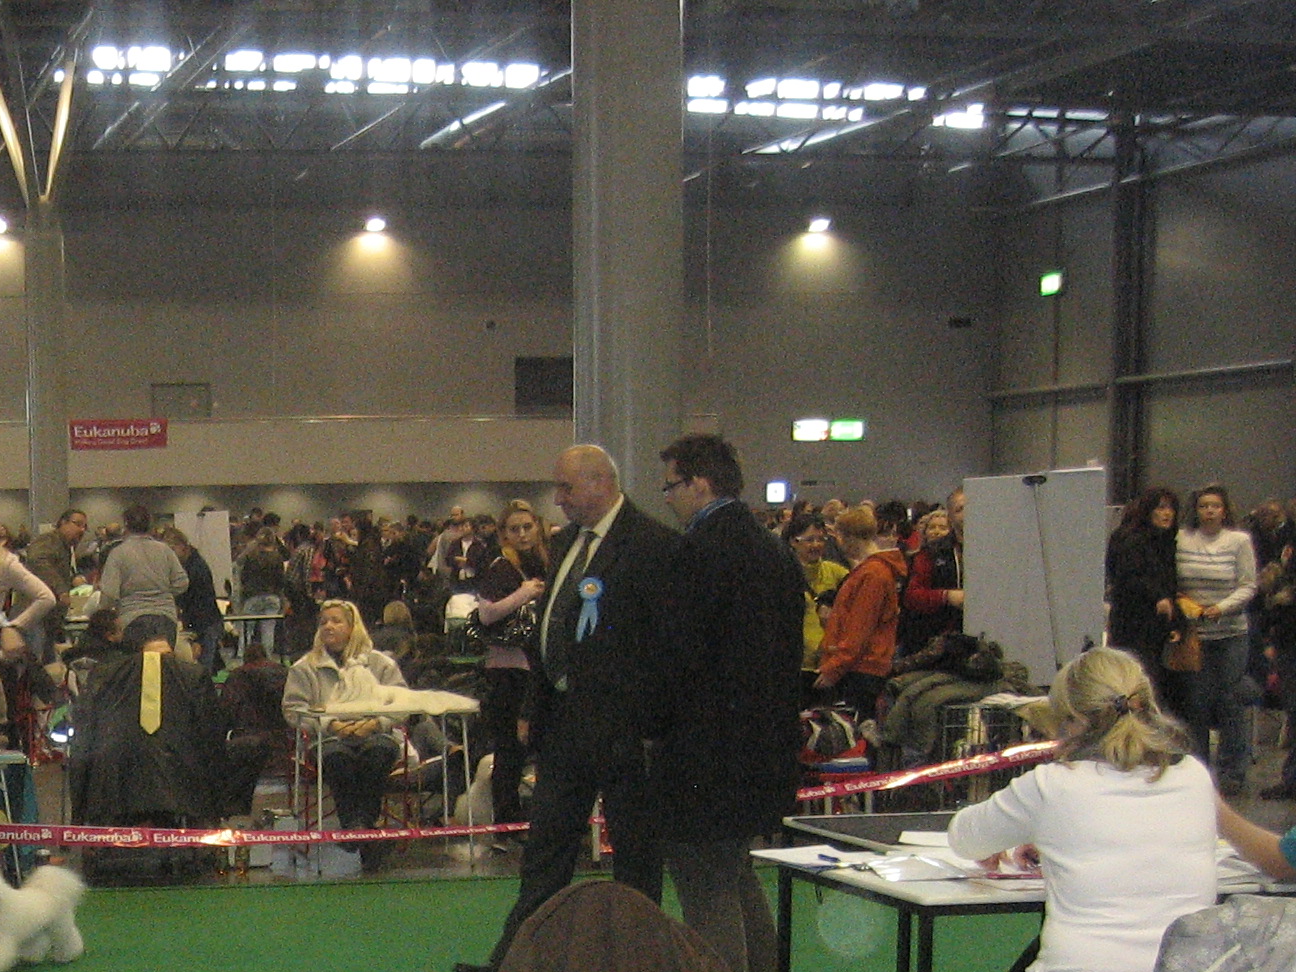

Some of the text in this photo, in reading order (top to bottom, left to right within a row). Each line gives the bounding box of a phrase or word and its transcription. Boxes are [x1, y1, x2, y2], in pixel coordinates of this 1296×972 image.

[74, 425, 148, 438] Eukanuba
[63, 830, 131, 843] Eukanuba
[242, 832, 311, 842] Eukanuba
[331, 829, 400, 841] Eukanuba
[420, 826, 487, 837] Eukanuba
